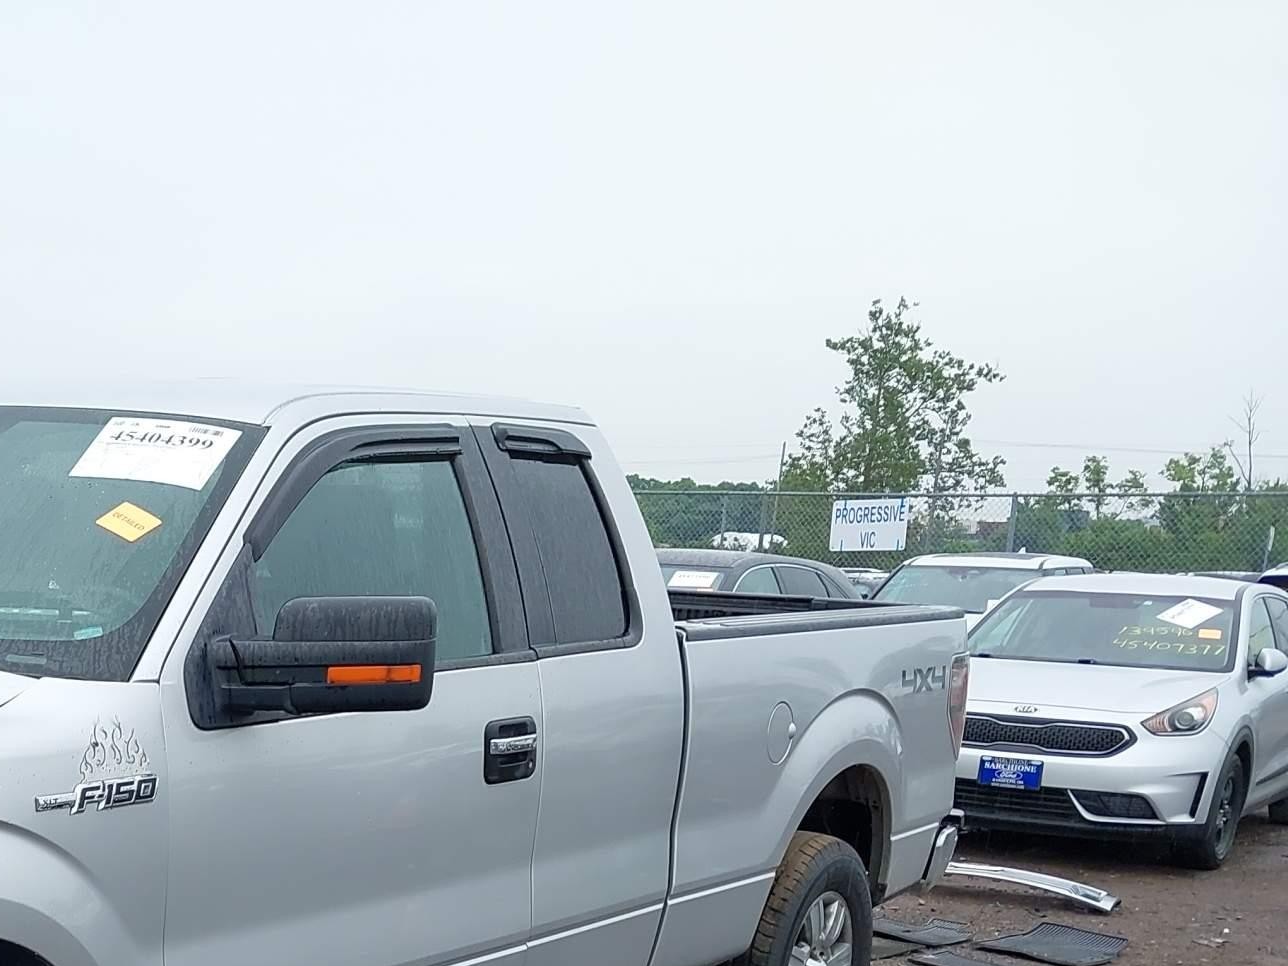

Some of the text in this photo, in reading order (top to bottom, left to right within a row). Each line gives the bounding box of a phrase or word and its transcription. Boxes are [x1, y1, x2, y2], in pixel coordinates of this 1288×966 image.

[109, 430, 215, 450] 45404399
[834, 504, 906, 525] PROGRESSIVE
[859, 531, 877, 549] VIC
[901, 664, 947, 694] 4X4
